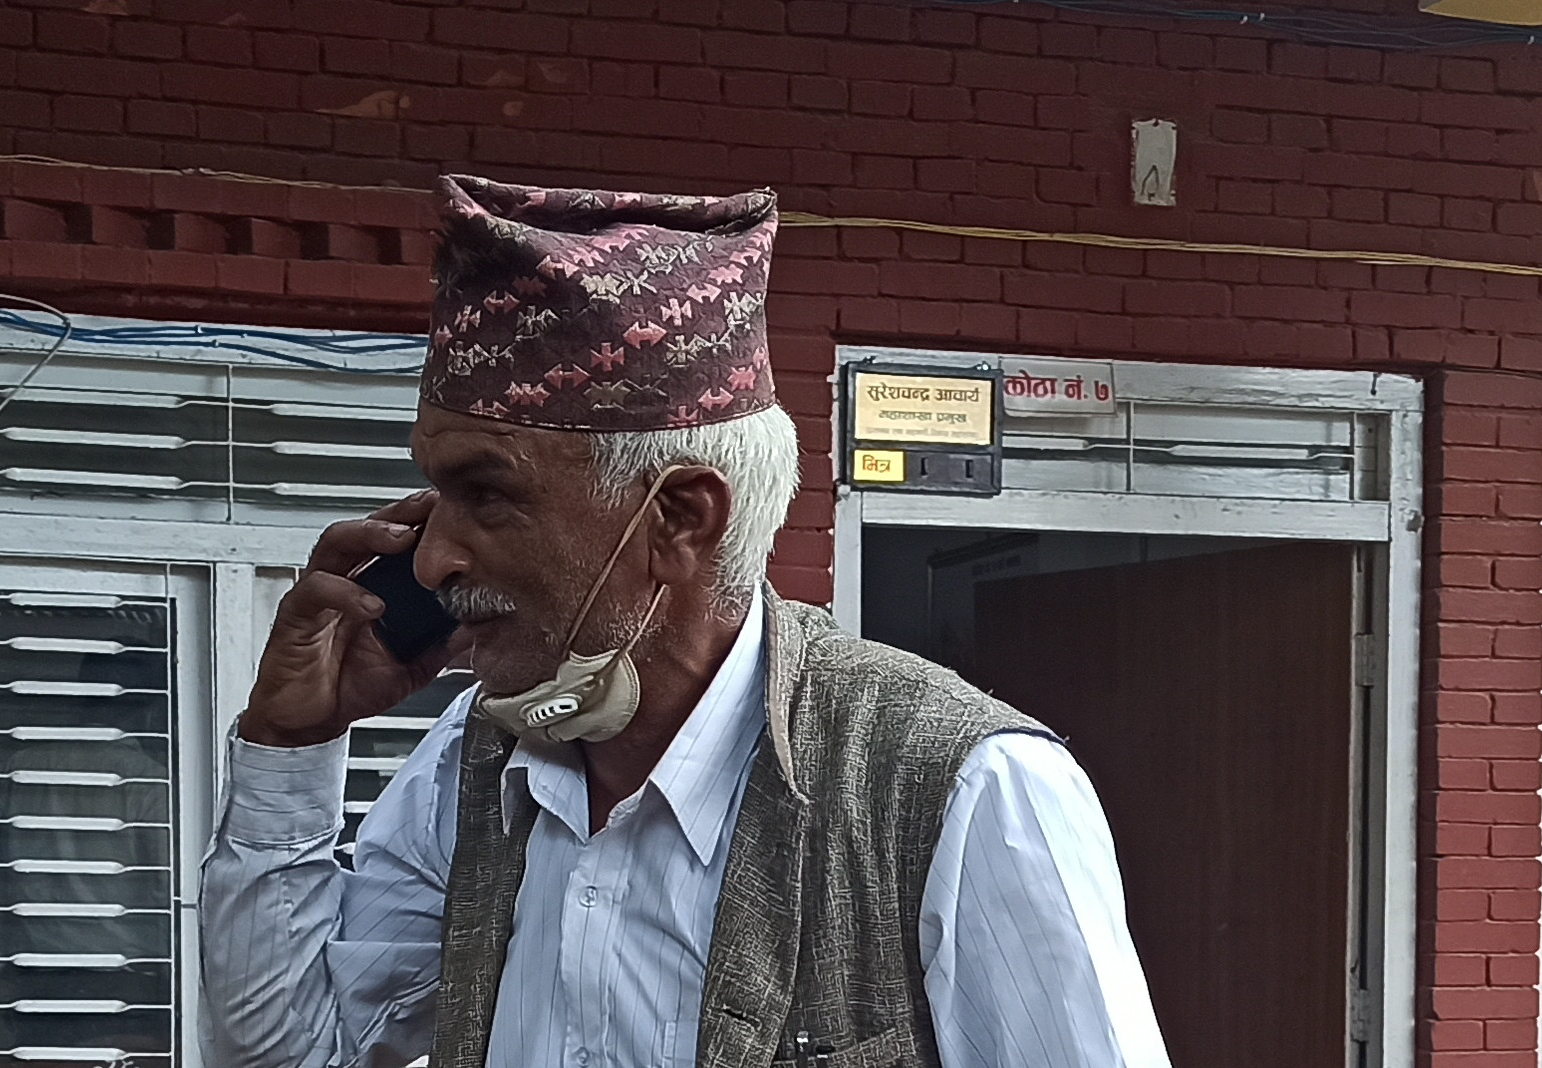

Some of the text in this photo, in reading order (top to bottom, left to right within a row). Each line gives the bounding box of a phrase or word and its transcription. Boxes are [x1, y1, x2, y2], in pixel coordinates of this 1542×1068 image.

[867, 382, 980, 402] सुरेशचन्द्र आचार्य
[1003, 369, 1058, 398] कोठा
[1094, 380, 1109, 401] ७
